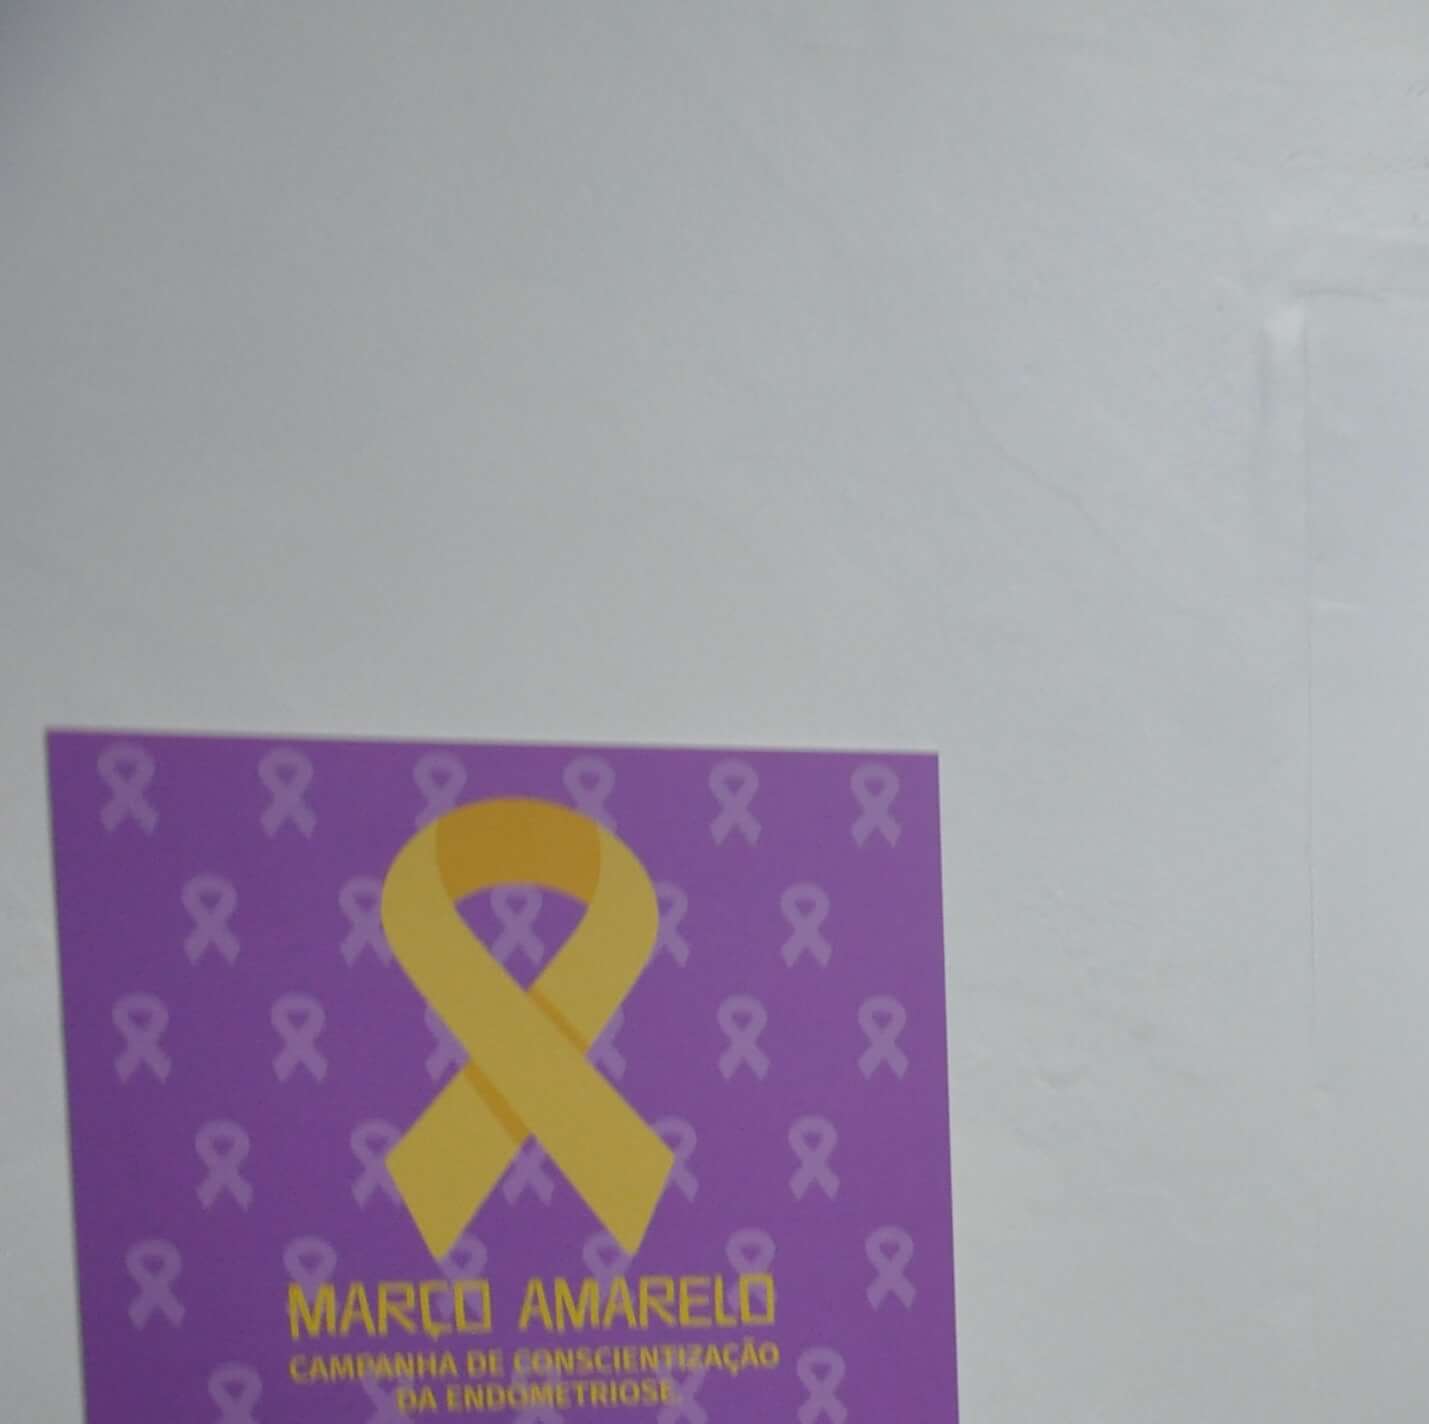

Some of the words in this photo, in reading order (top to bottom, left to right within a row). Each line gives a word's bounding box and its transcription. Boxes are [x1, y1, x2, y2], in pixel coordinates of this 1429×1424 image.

[288, 1279, 492, 1342] MARÇO
[518, 1272, 775, 1333] AMARELO
[289, 1350, 458, 1383] CAMPANHA
[466, 1348, 502, 1377] DE
[512, 1337, 780, 1376] CONSCIENTIZAÇÃO
[395, 1384, 438, 1413] DA
[446, 1378, 674, 1413] ENDOMETRIOSE
